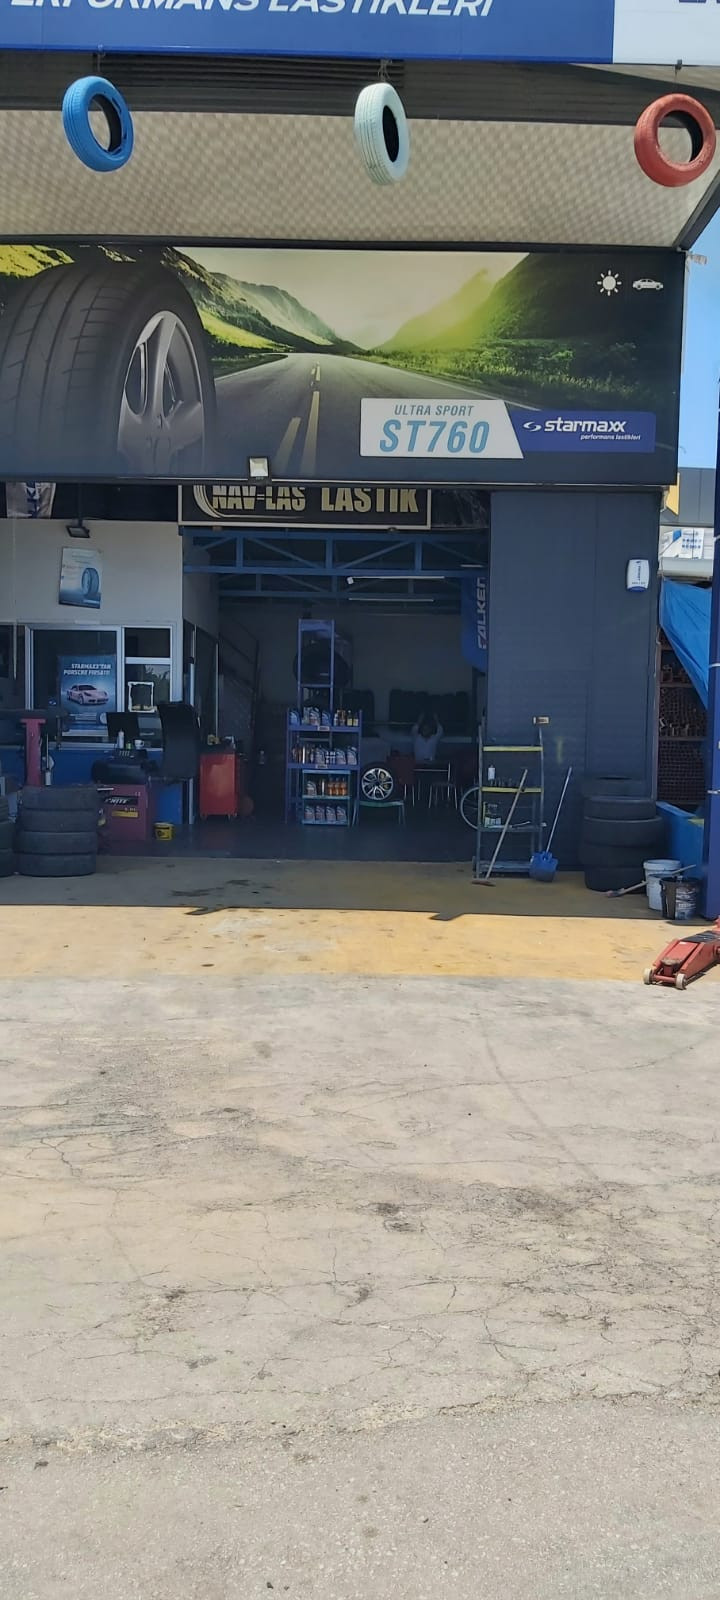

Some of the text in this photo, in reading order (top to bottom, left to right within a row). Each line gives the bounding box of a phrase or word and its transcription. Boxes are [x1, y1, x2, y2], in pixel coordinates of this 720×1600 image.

[394, 404, 475, 417] ULTRA SPORT
[544, 417, 627, 432] starmaxx
[379, 419, 490, 453] ST760
[212, 485, 306, 511] NAV-LAS
